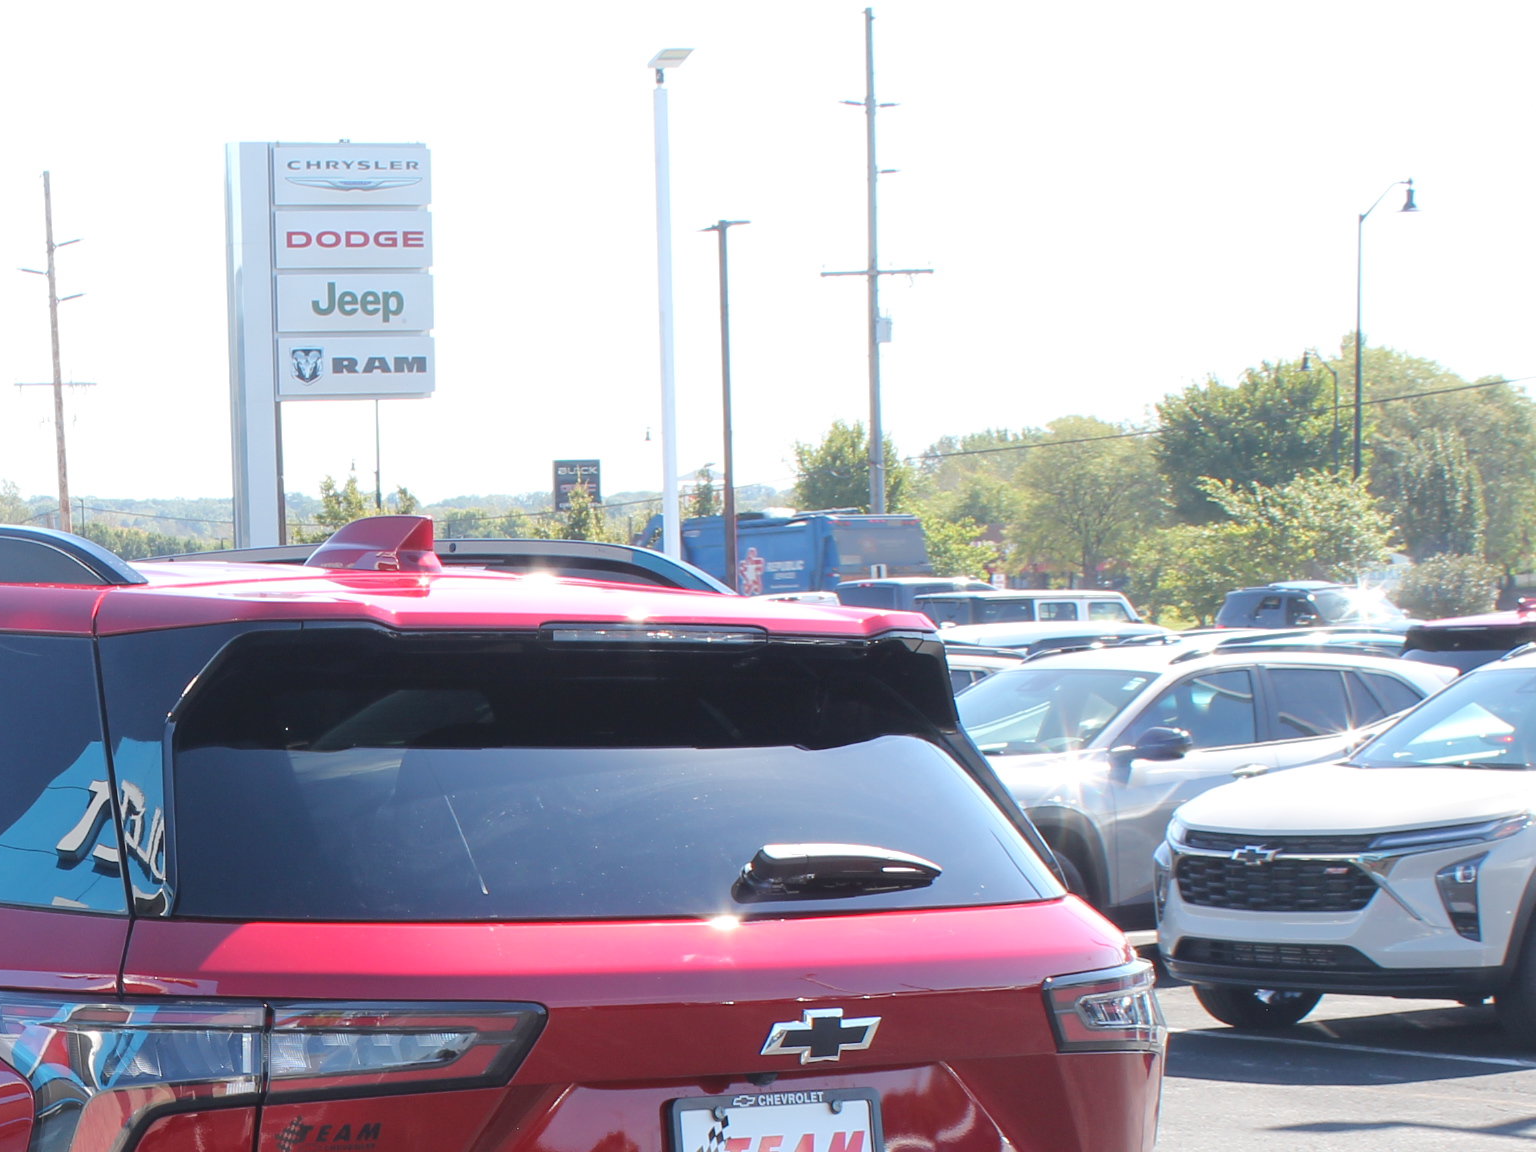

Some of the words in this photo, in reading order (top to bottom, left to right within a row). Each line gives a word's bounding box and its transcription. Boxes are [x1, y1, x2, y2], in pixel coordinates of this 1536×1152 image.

[286, 160, 420, 171] CHRYSLER
[285, 231, 425, 248] DODGE
[311, 281, 405, 323] Jeep
[331, 356, 427, 374] RAM
[557, 466, 598, 475] BUCK
[757, 1092, 824, 1107] CHEVROLET
[297, 1122, 382, 1143] TEAM
